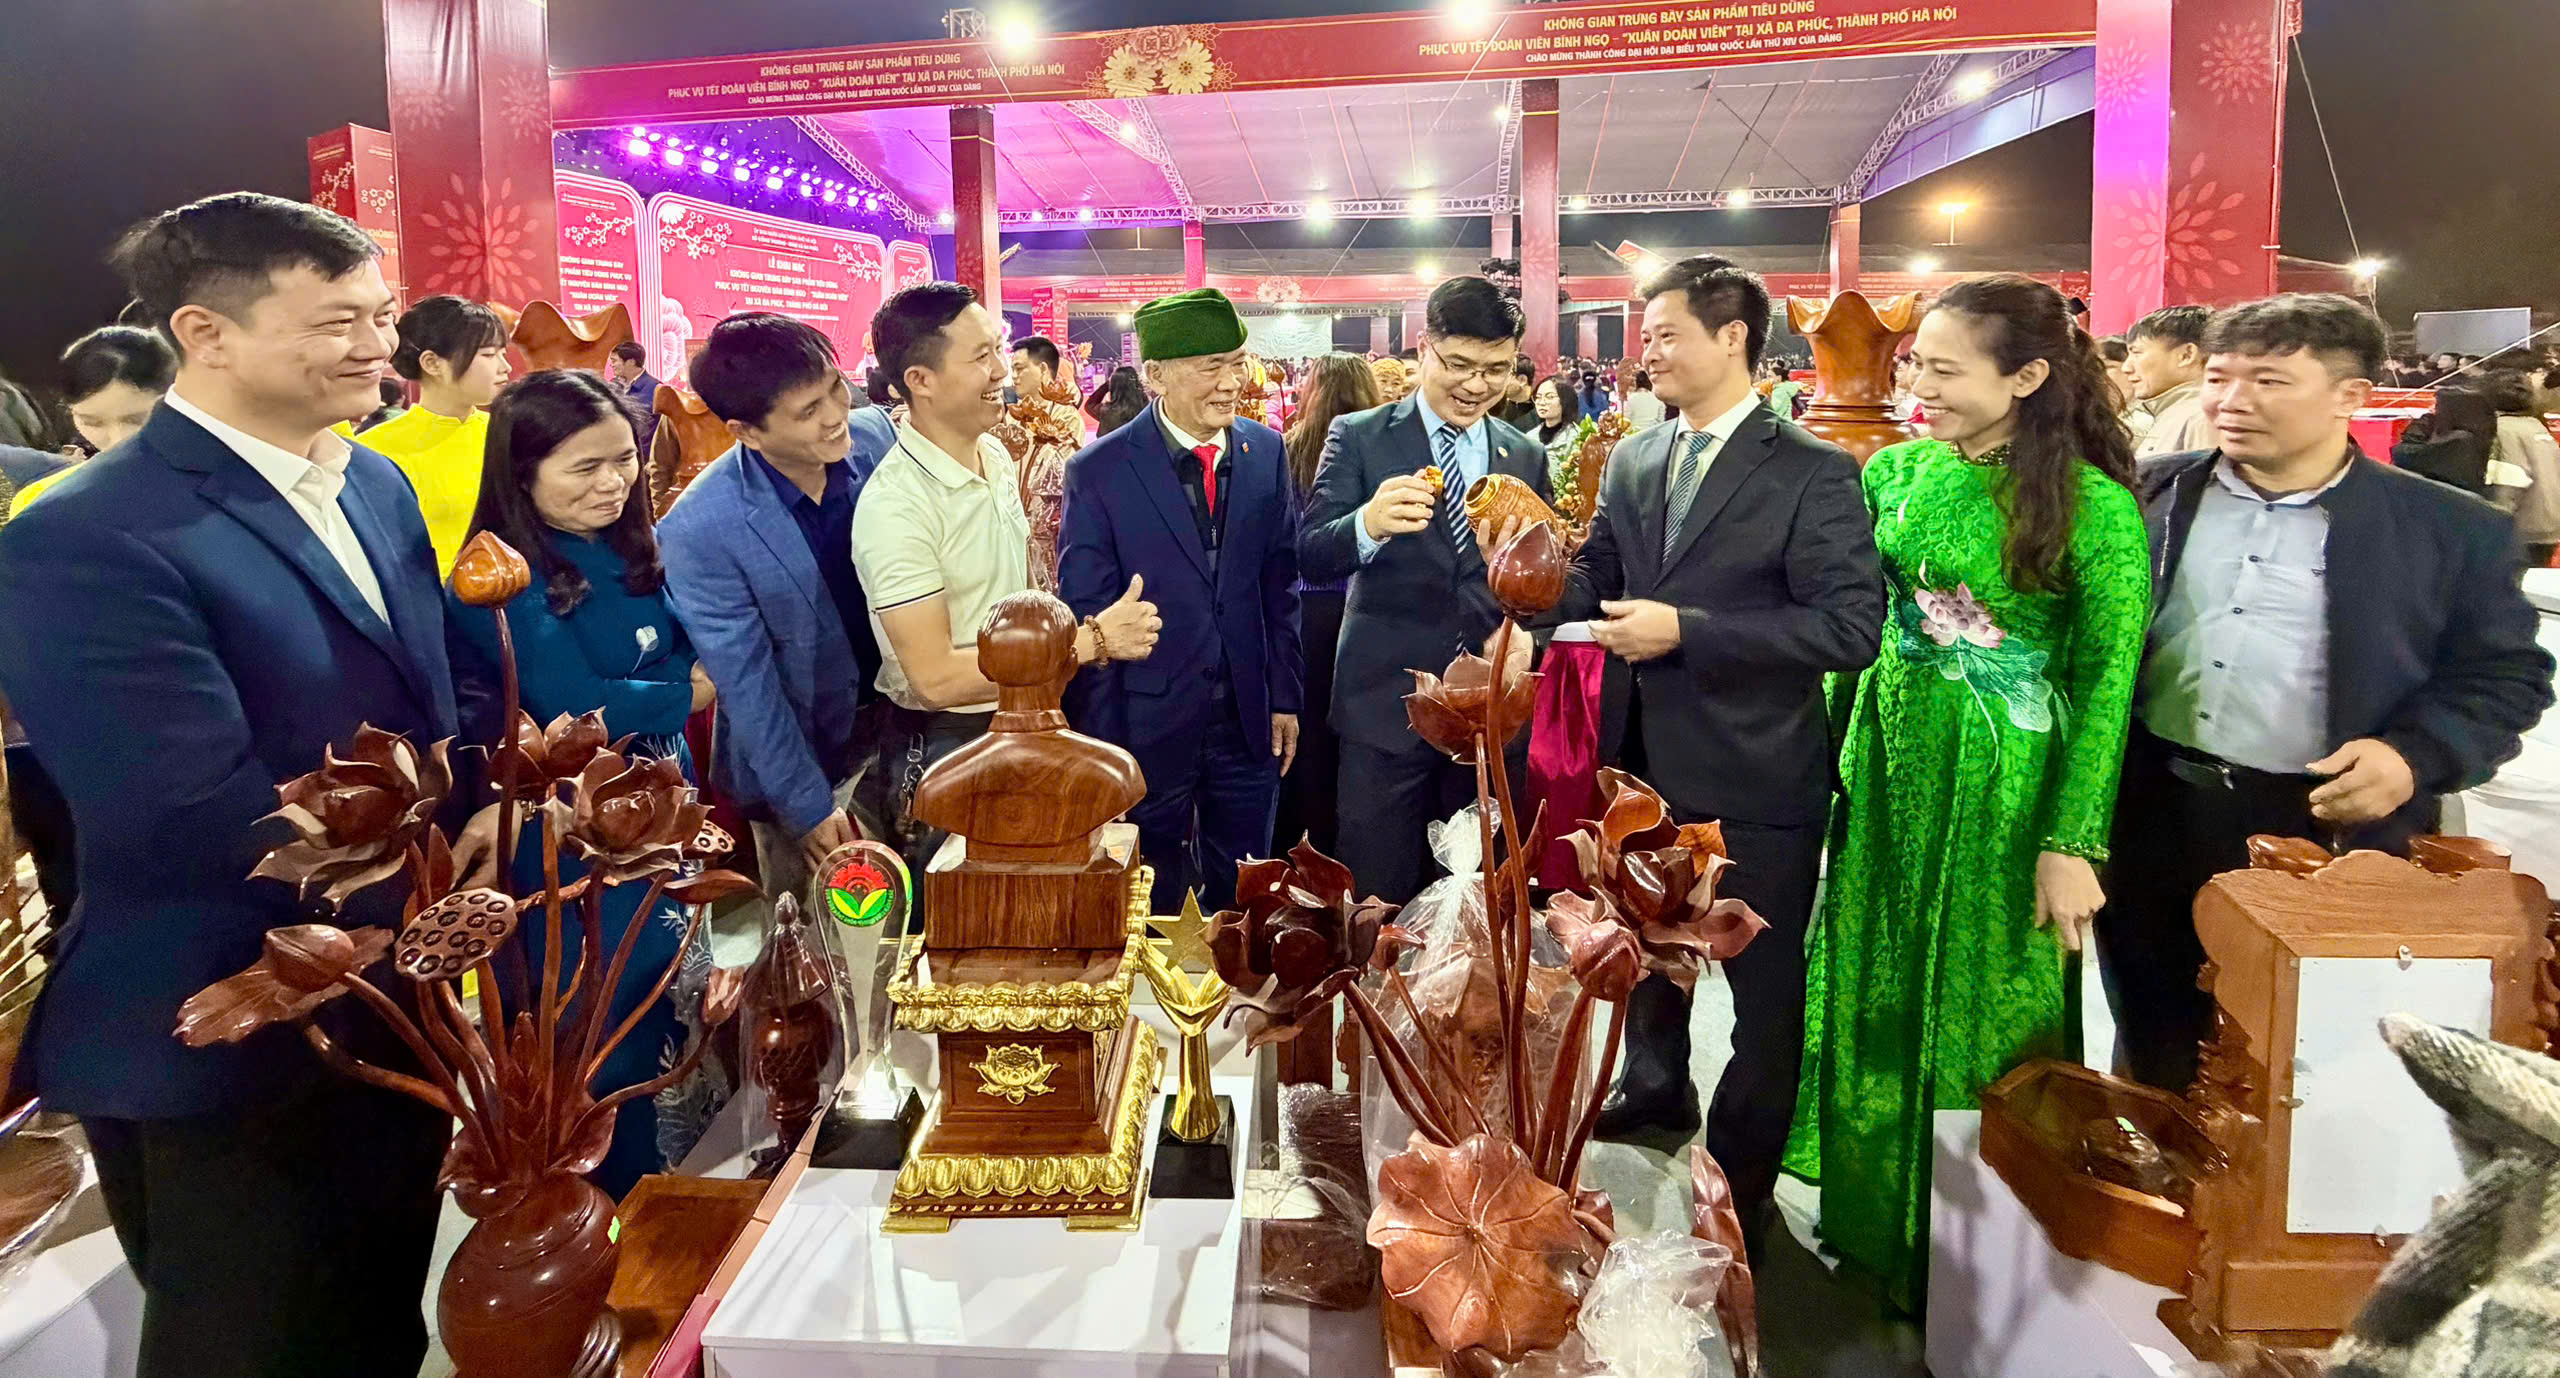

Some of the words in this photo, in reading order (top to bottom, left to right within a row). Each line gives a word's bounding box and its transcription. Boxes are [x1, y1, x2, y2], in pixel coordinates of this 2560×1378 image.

[1419, 43, 1450, 57] PHỤC
[1451, 42, 1467, 56] VỤ
[1490, 37, 1523, 52] ĐOÀN
[1525, 35, 1551, 50] VIÊN
[1553, 34, 1581, 48] BÍNH
[1583, 33, 1610, 47] NGỌ
[1662, 26, 1697, 42] ĐOÀN
[1735, 23, 1754, 37] TẠI
[1756, 21, 1774, 35] XÃ
[1776, 20, 1794, 33] ĐA
[1796, 16, 1833, 31] PHÚC,
[1836, 13, 1879, 29] THÀNH
[1881, 7, 1910, 25] PHỐ
[1912, 8, 1931, 23] HÀ
[1933, 6, 1958, 20] NỘI
[1543, 16, 1584, 31] KHÔNG
[1587, 15, 1616, 28] GIAN
[1618, 12, 1658, 27] TRƯNG
[1660, 9, 1685, 24] BÀY
[1686, 6, 1710, 22] SẢN
[1713, 2, 1748, 20] PHẨM
[1751, 2, 1777, 16] TIÊU
[1779, 0, 1815, 14] DÙNG
